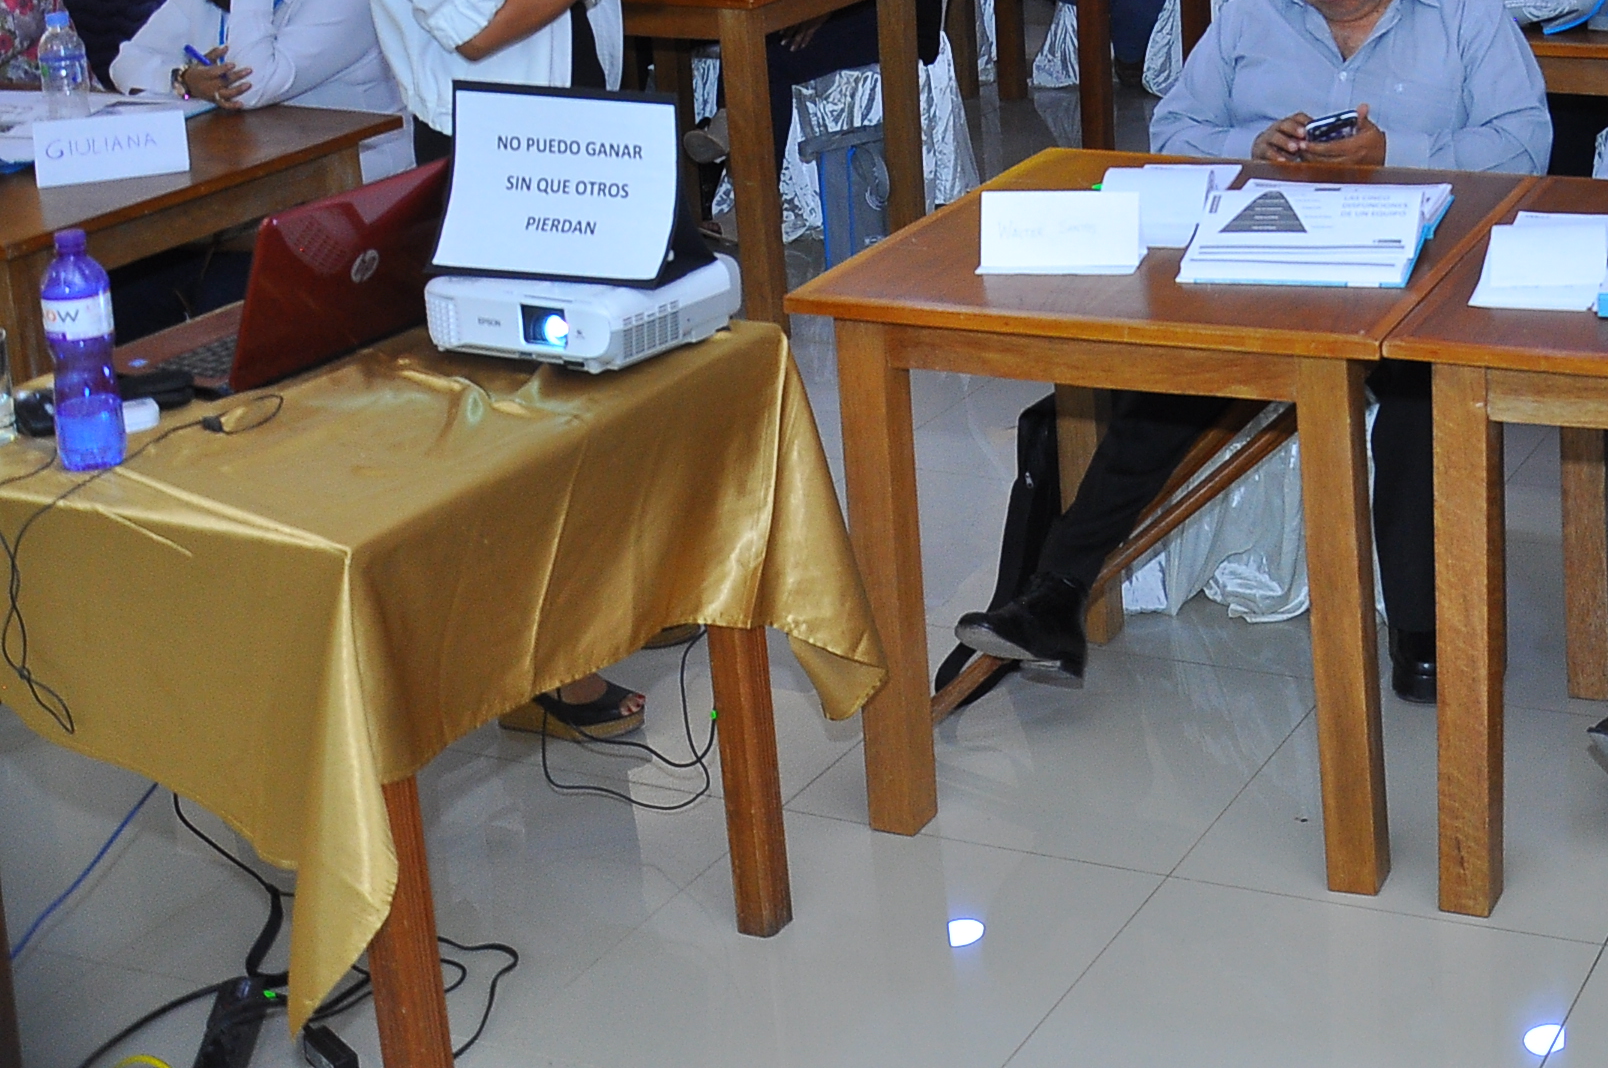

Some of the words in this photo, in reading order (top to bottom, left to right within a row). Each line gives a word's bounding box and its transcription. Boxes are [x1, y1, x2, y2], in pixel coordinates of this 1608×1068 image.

[45, 132, 158, 160] GIULIANA
[497, 134, 522, 151] NO
[526, 136, 581, 156] PUEDO
[585, 140, 643, 160] GANAR
[505, 175, 532, 192] SIN
[536, 177, 571, 196] QUE
[574, 180, 629, 199] OTROS
[525, 216, 597, 236] PIERDAN
[477, 317, 502, 328] EPSON
